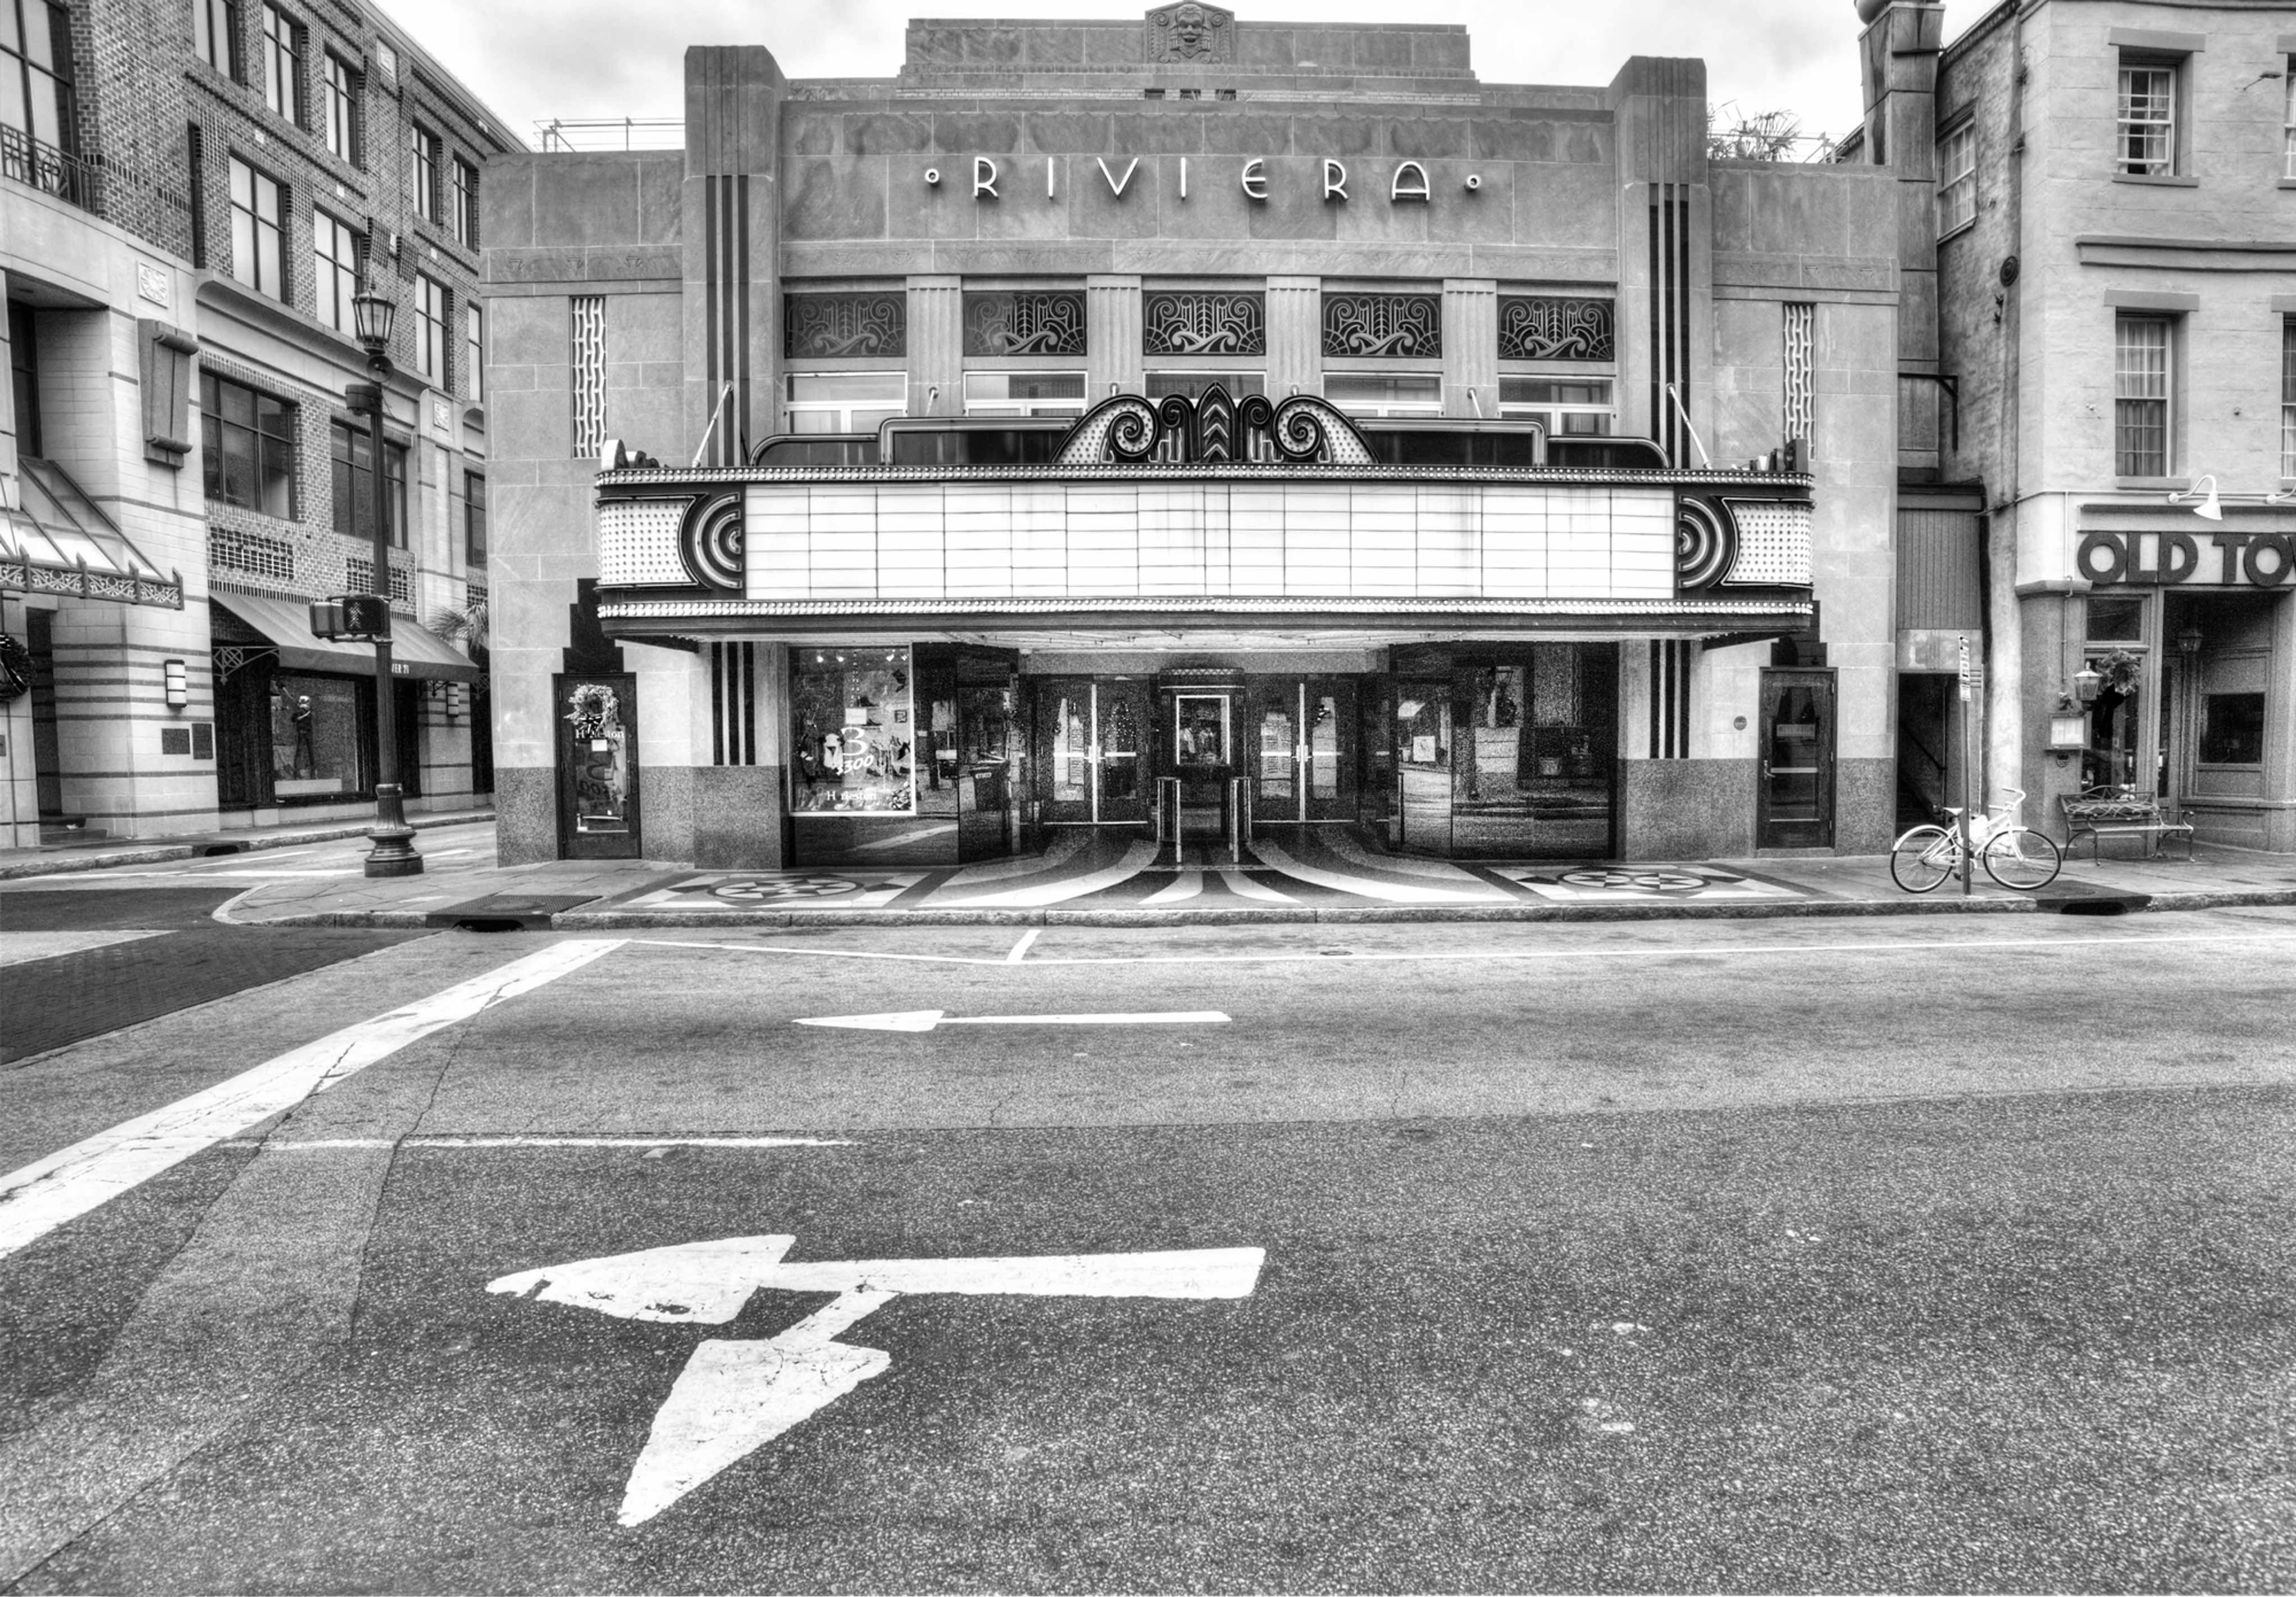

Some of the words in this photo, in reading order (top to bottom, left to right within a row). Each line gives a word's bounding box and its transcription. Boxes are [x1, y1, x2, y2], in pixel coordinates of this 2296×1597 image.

[973, 156, 1431, 201] RIVIERA
[2078, 531, 2199, 585] OLD
[2212, 531, 2296, 588] TO
